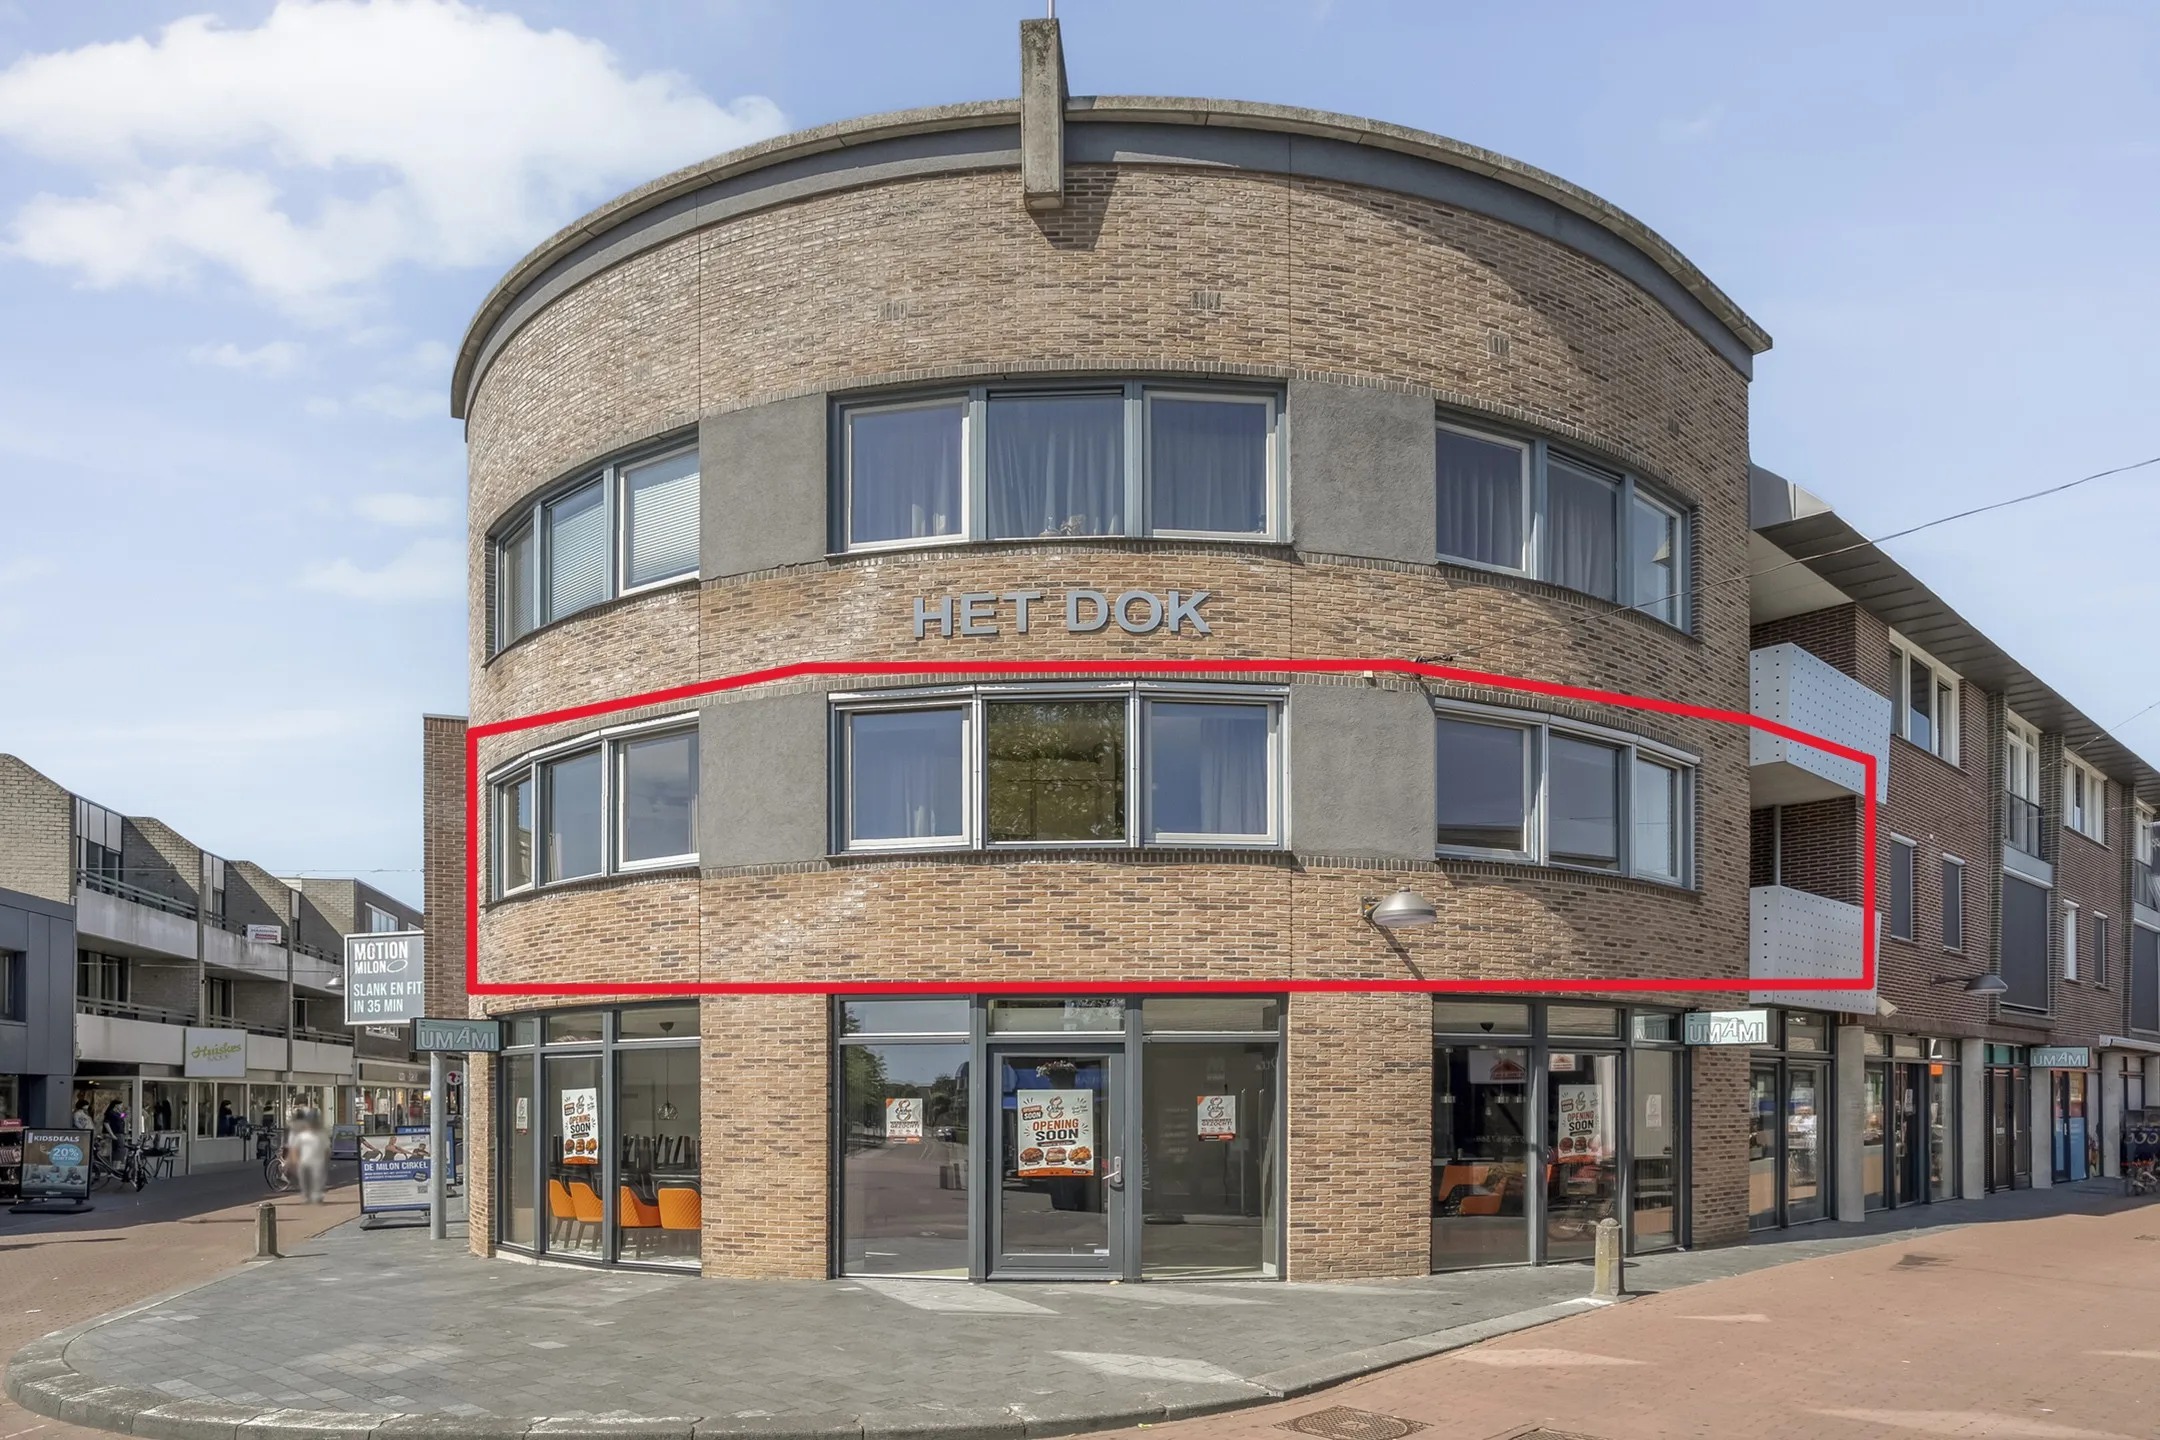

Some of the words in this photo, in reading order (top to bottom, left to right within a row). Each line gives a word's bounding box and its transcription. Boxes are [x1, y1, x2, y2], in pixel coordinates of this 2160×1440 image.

[913, 591, 1042, 638] HET
[1065, 589, 1212, 635] DOK
[354, 941, 408, 960] MOTION
[354, 960, 387, 974] MILON
[353, 982, 387, 997] SLANK
[390, 981, 404, 995] EN
[407, 981, 422, 995] FIT
[353, 1000, 364, 1013] IN
[367, 999, 381, 1012] 35
[384, 999, 404, 1012] MIN
[2033, 1052, 2086, 1066] UMAMI
[1567, 1111, 1594, 1123] OPENING
[570, 1123, 591, 1133] SOON
[1033, 1118, 1079, 1131] OPENING
[1569, 1120, 1594, 1131] SOON
[1035, 1129, 1079, 1141] SOON
[53, 1147, 79, 1157] 20%
[364, 1163, 375, 1172] DE
[376, 1162, 400, 1171] MILON
[402, 1161, 429, 1169] CIRKEL
